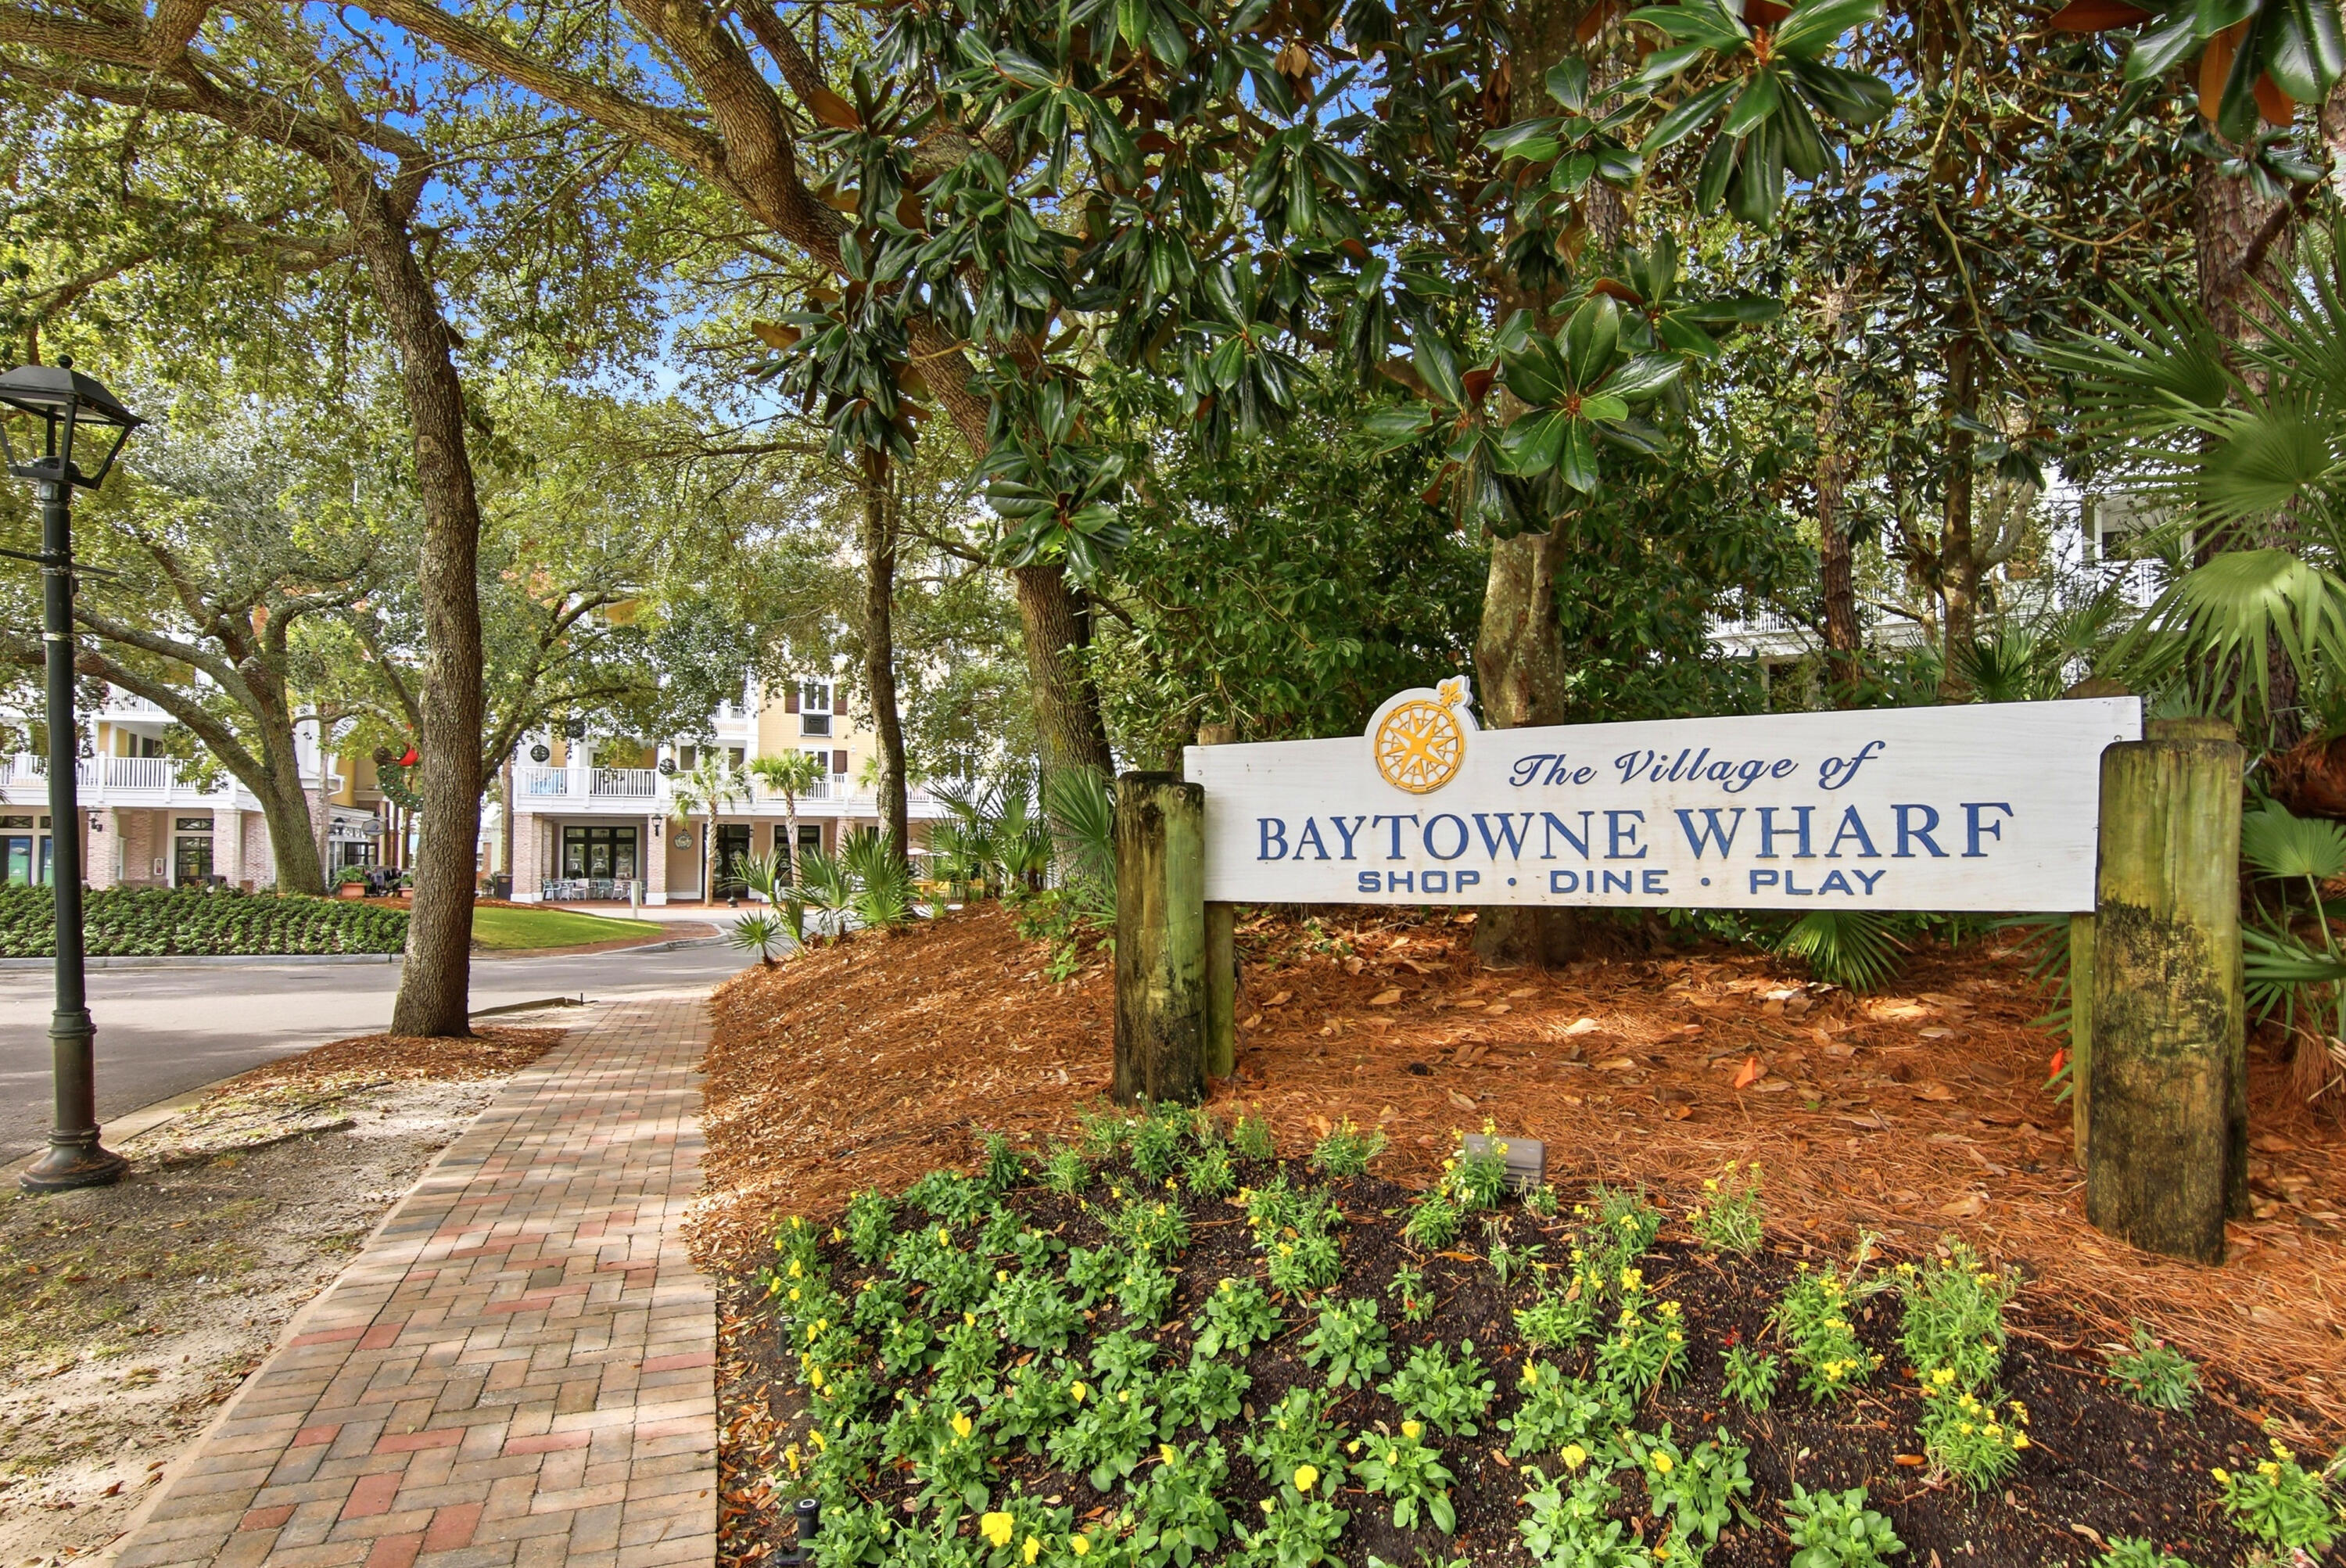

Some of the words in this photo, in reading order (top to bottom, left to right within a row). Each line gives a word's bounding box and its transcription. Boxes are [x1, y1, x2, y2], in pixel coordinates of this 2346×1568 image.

[1509, 753, 1598, 788] The
[1614, 747, 1799, 792] Village
[1817, 740, 1886, 791] of
[1256, 810, 1648, 860] BAYTOWNE
[1673, 802, 2014, 859] WHARF
[1358, 870, 1480, 893] SHOP
[1550, 870, 1669, 894] DINE
[1749, 869, 1886, 895] PLAY
